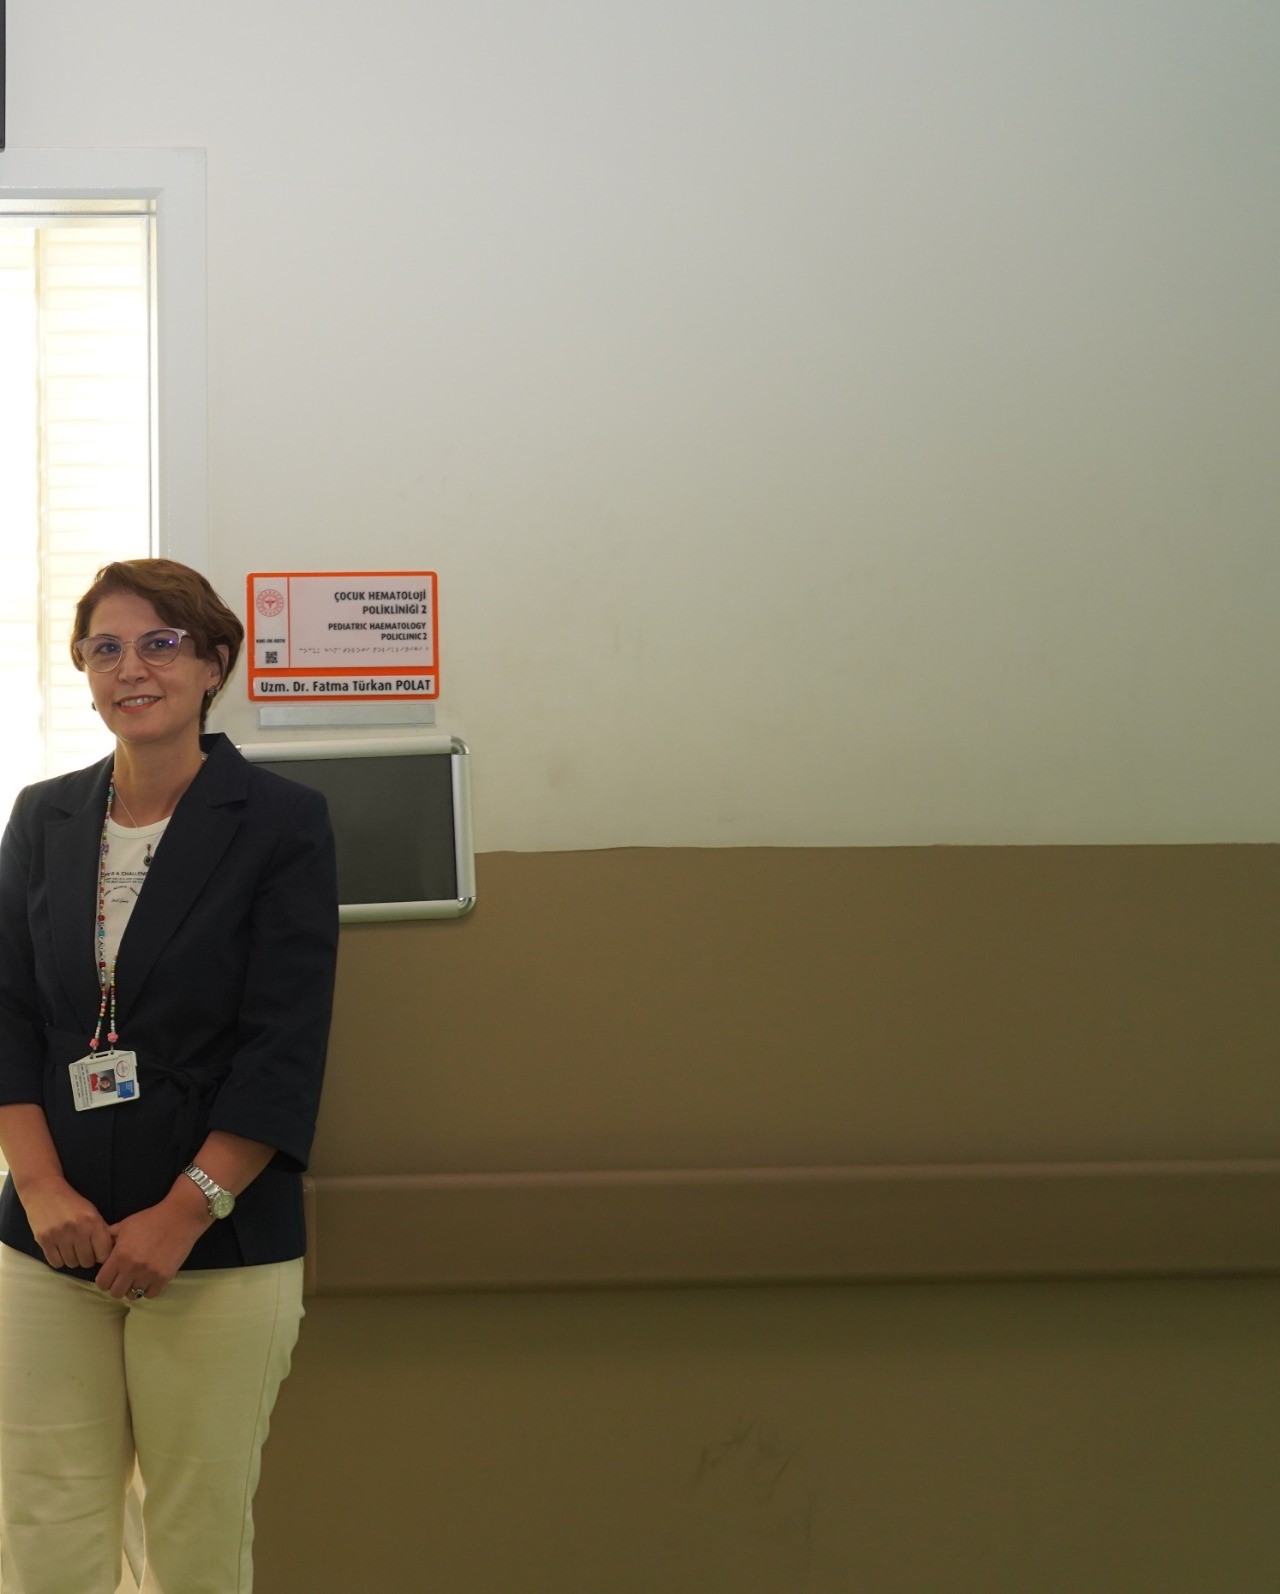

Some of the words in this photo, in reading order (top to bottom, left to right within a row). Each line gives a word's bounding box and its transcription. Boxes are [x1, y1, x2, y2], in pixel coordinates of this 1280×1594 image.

[334, 591, 366, 603] ÇOCUK
[362, 603, 419, 614] POLİKLİNİĞİ
[421, 605, 427, 614] 2
[328, 622, 367, 630] PEDIATRIC
[369, 622, 426, 630] HAEMATOLOGY
[381, 632, 422, 640] POLICLINIC
[422, 632, 428, 640] 2
[260, 681, 290, 692] Uzm.
[293, 681, 309, 692] Dr.
[313, 681, 349, 692] Fatma
[353, 679, 392, 691] Türkan
[396, 679, 431, 691] POLAT
